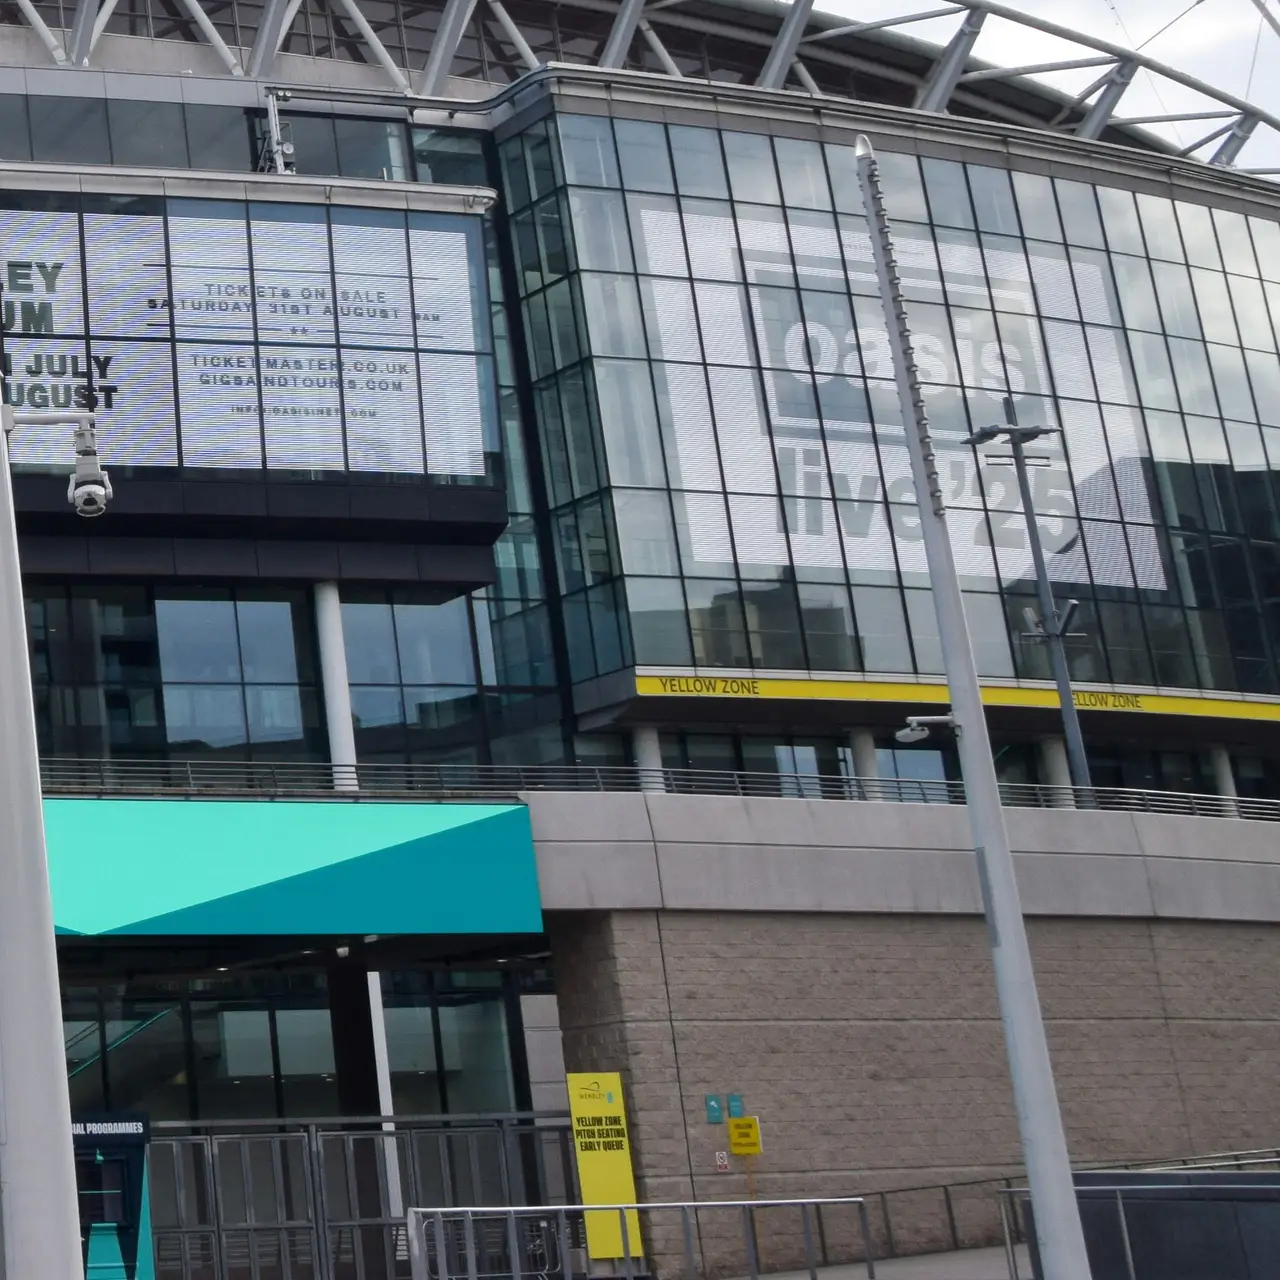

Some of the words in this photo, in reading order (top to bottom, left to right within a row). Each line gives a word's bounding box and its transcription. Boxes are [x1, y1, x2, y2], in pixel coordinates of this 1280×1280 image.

[204, 283, 291, 299] TICKETS
[300, 287, 326, 301] ON
[341, 289, 386, 303] SALE
[147, 298, 253, 313] SATURDAY
[269, 302, 312, 316] 31ST
[322, 305, 400, 319] AUGUST
[25, 353, 113, 380] JULY
[191, 353, 409, 375] TICKETMASTER.CO.UK
[784, 316, 1026, 403] oasis
[3, 382, 118, 411] UGUST
[659, 678, 717, 693] YELLOW
[720, 680, 759, 694] ZONE
[1111, 694, 1142, 709] ZONE
[86, 1121, 144, 1134] PROGRAMMES
[576, 1116, 603, 1127] YELLOW
[605, 1116, 622, 1126] ZONE
[576, 1129, 596, 1139] PITCH
[597, 1128, 626, 1139] SEATING
[580, 1140, 601, 1152] EARLY
[603, 1140, 624, 1152] QUEUE
